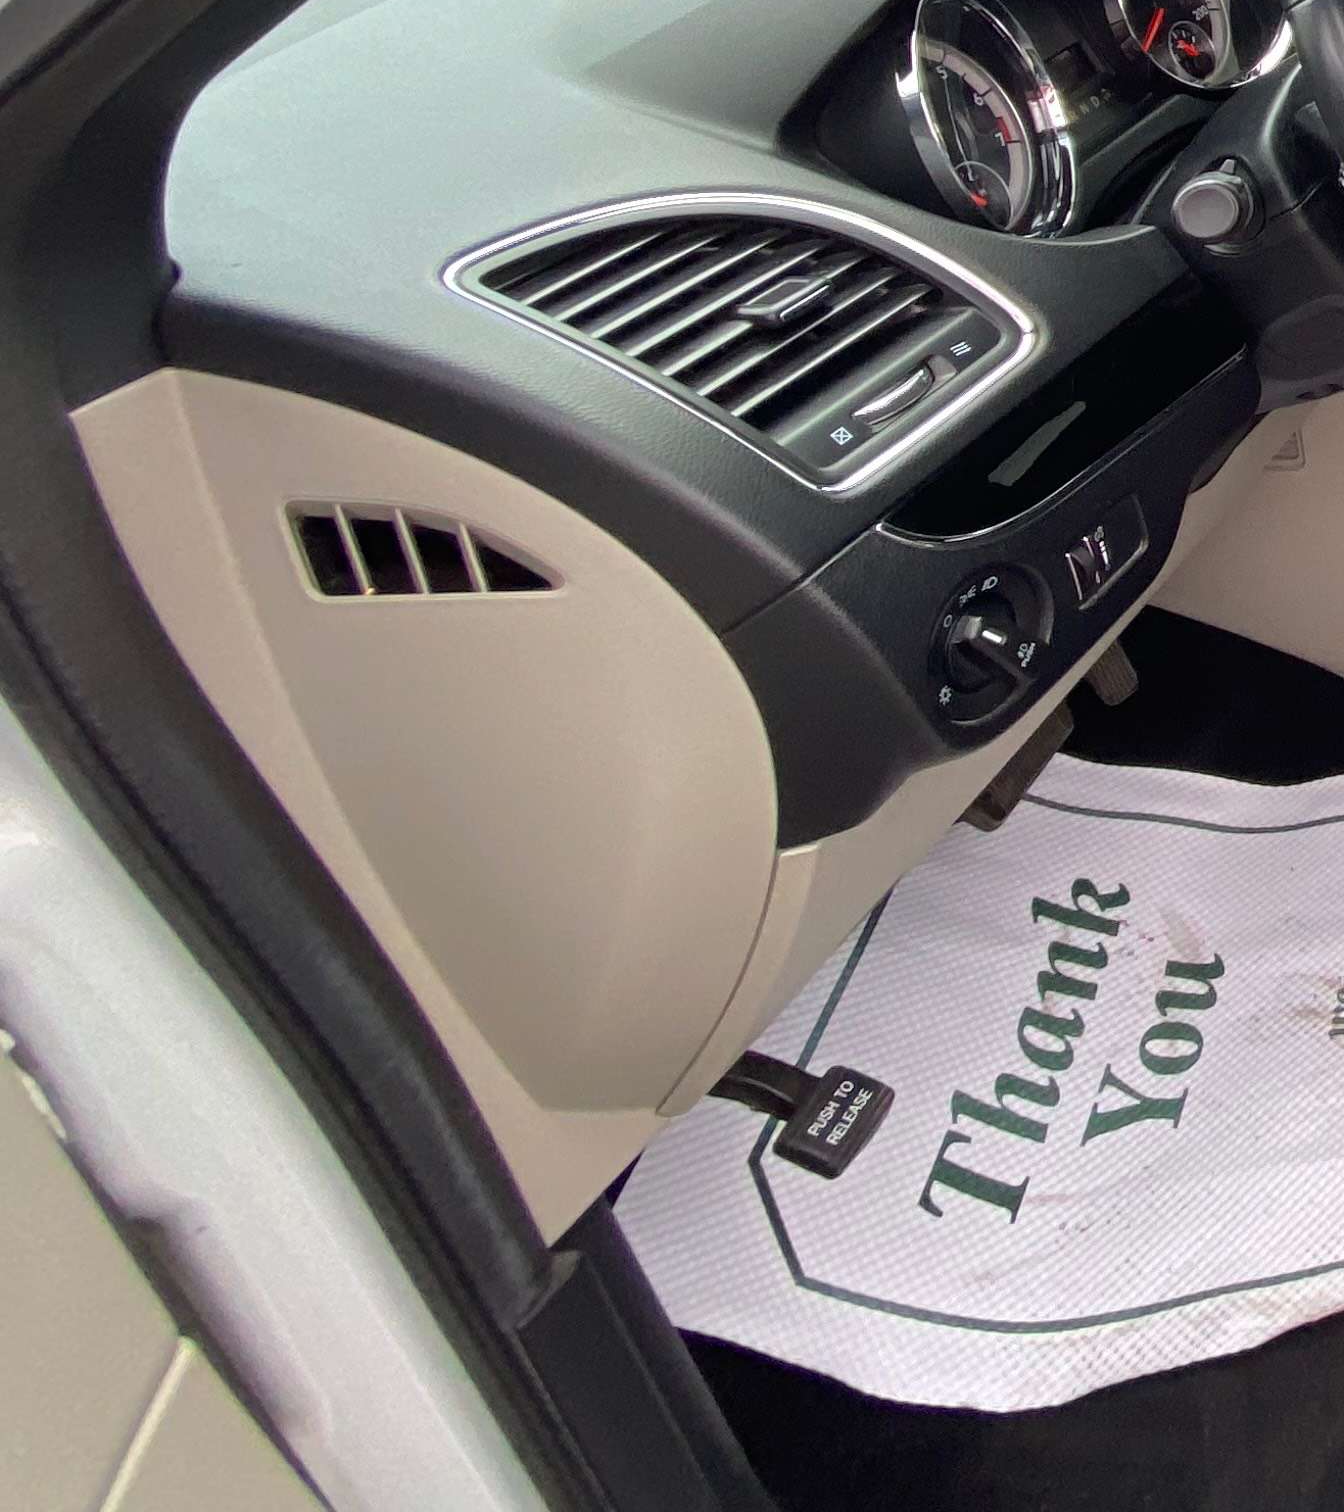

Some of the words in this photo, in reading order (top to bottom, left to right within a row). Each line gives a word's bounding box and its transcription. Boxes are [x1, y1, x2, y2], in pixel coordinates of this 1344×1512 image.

[807, 1100, 841, 1137] PUSH
[834, 1080, 855, 1099] TO
[917, 877, 1132, 1225] Thank
[1081, 952, 1226, 1147] You
[826, 1088, 874, 1145] RELEASE
